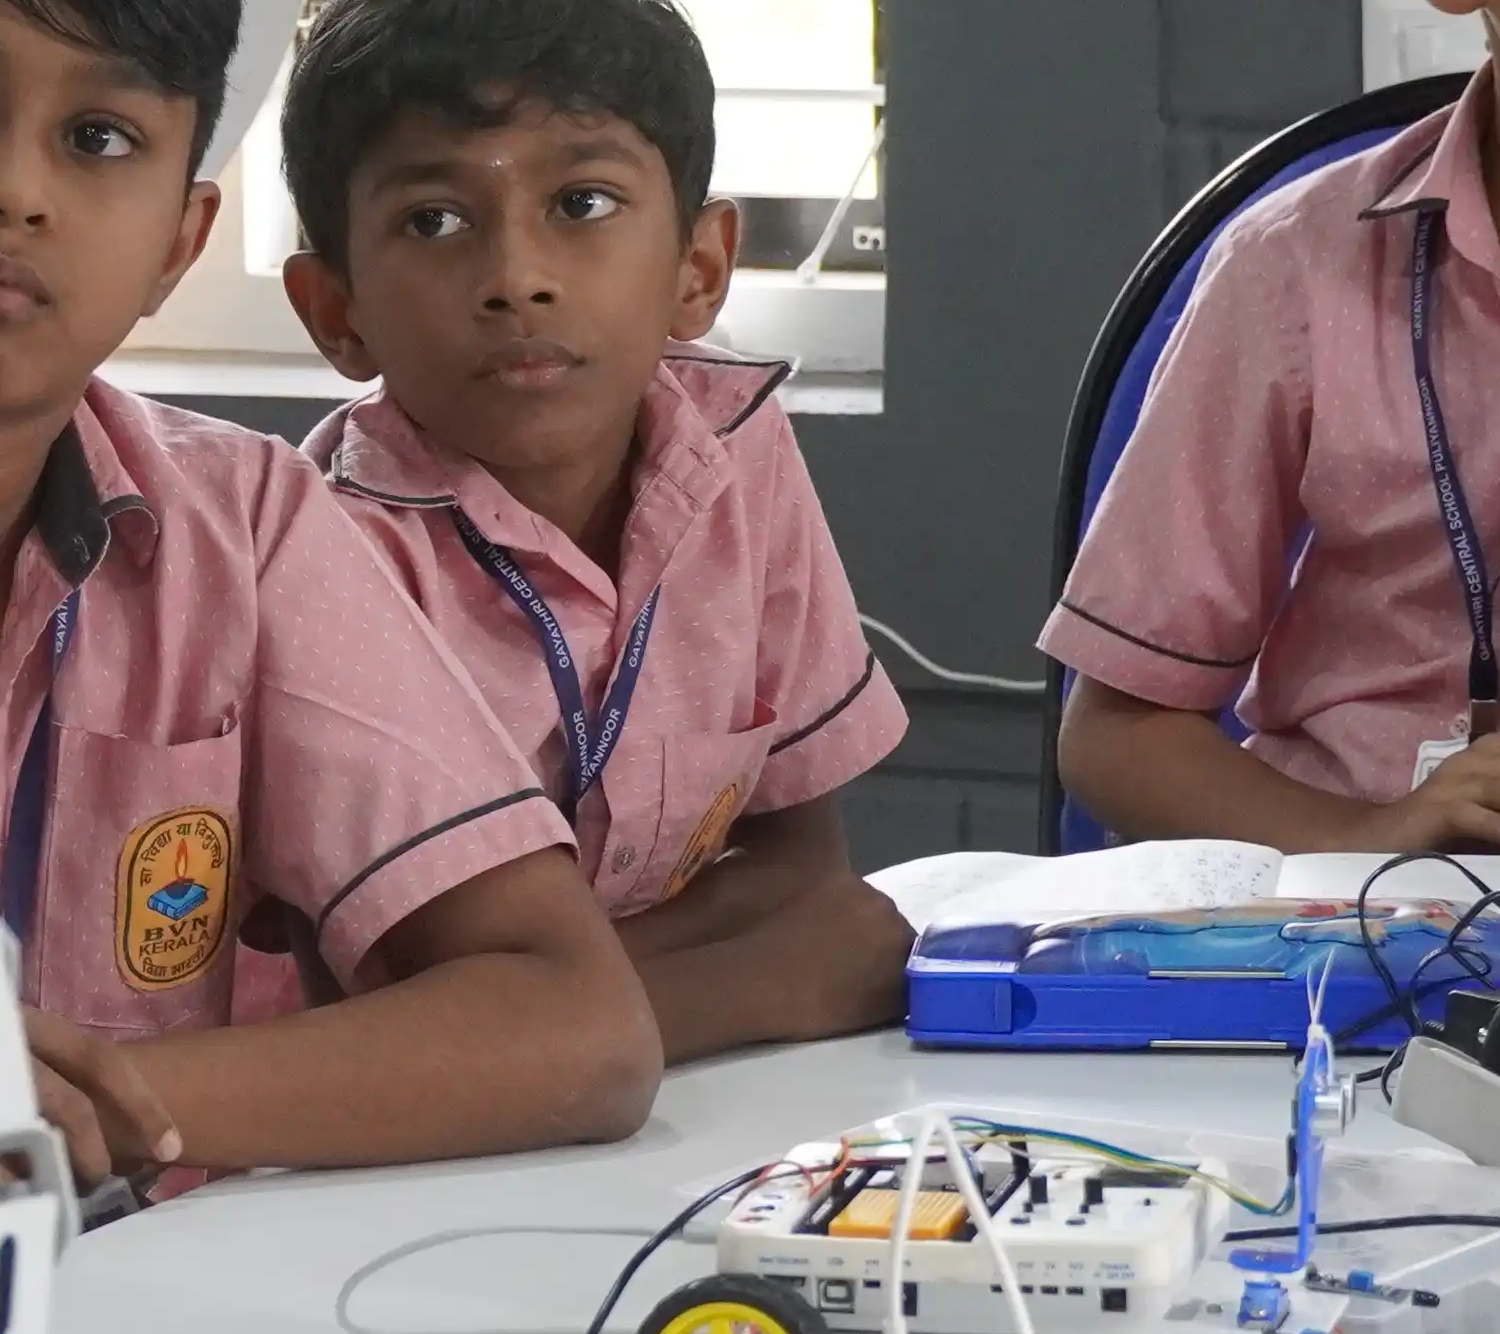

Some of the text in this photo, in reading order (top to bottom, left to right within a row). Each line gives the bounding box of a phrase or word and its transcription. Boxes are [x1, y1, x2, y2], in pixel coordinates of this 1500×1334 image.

[1438, 474, 1462, 530] SCHOOL
[484, 543, 534, 600] CENTRAL
[1453, 530, 1483, 594] CENTRAL
[529, 597, 570, 670] GAYATHRI
[139, 930, 211, 958] KERALA
[144, 915, 209, 942] BVN
